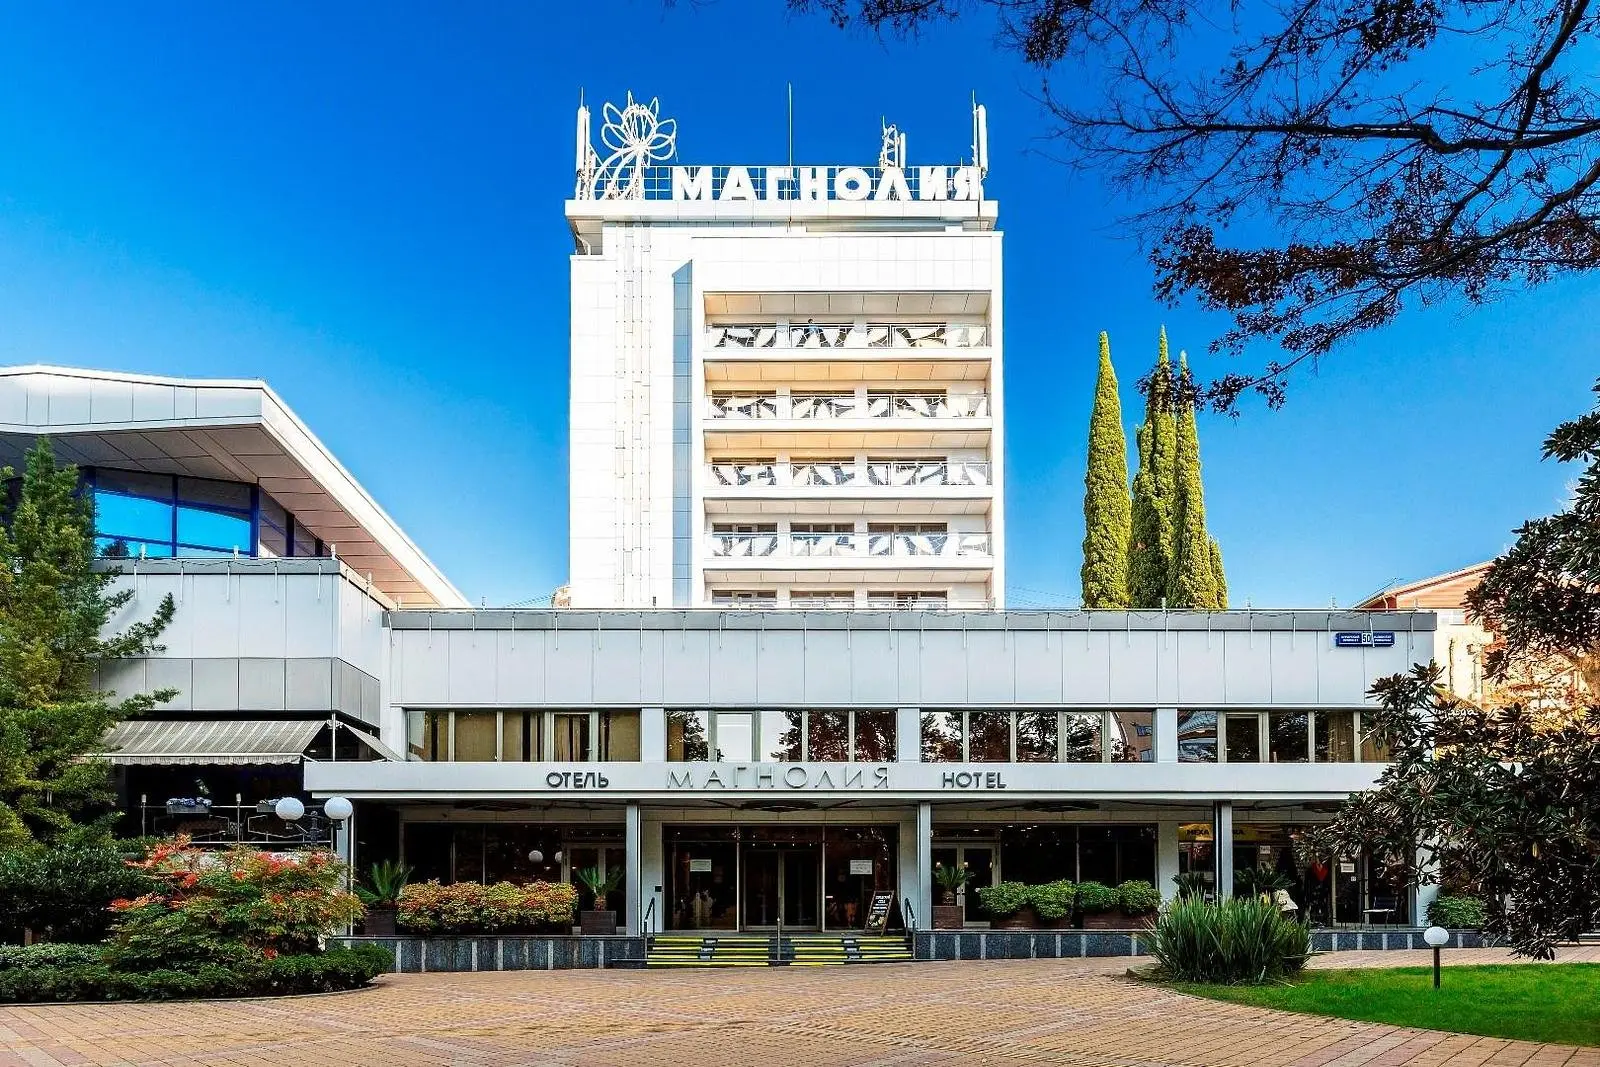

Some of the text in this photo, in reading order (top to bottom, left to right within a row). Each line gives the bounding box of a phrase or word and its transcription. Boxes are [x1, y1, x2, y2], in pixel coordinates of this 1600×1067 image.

[672, 166, 980, 201] МАГНОЛИЯ
[1362, 633, 1371, 643] 50
[546, 766, 1008, 789] ОТЕЛЬ МАГНОЛИЯ HOTEL
